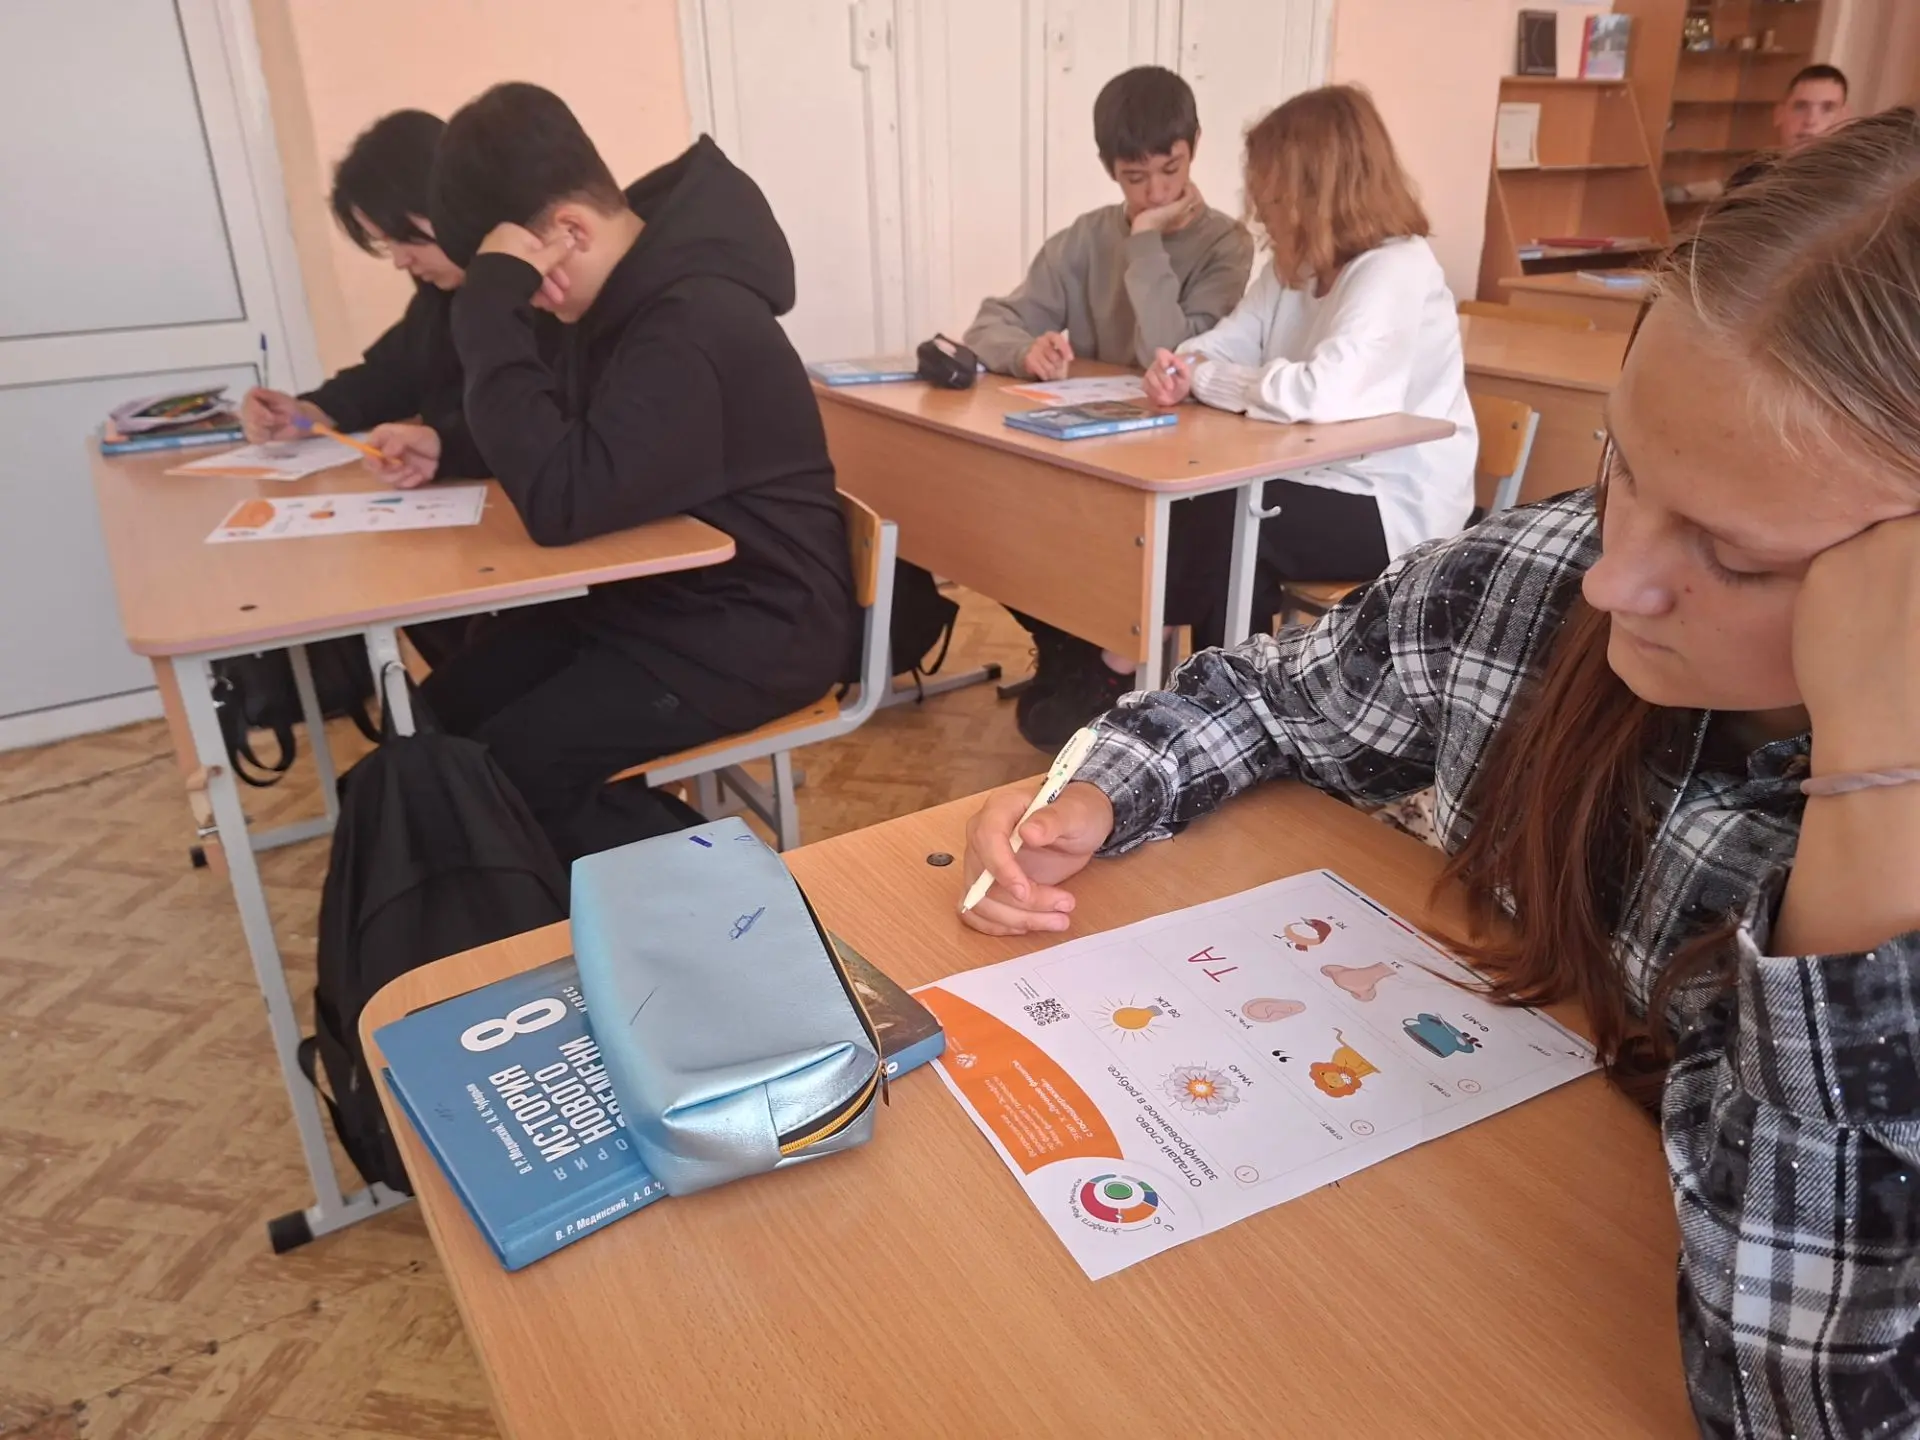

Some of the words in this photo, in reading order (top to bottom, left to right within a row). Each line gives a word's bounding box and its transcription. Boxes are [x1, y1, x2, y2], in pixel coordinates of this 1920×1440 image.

[1188, 946, 1238, 983] ТА
[461, 998, 567, 1051] 8
[488, 1064, 582, 1163] ИСТОРИЯ
[534, 1062, 618, 1145] НОВОГО
[1143, 1104, 1219, 1181] зашифрованное
[1160, 1145, 1202, 1187] Отгадай
[555, 1230, 566, 1241] В.
[566, 1224, 575, 1236] Р.
[576, 1197, 630, 1231] Мединский,
[633, 1191, 643, 1202] А.
[643, 1185, 654, 1197] О.
